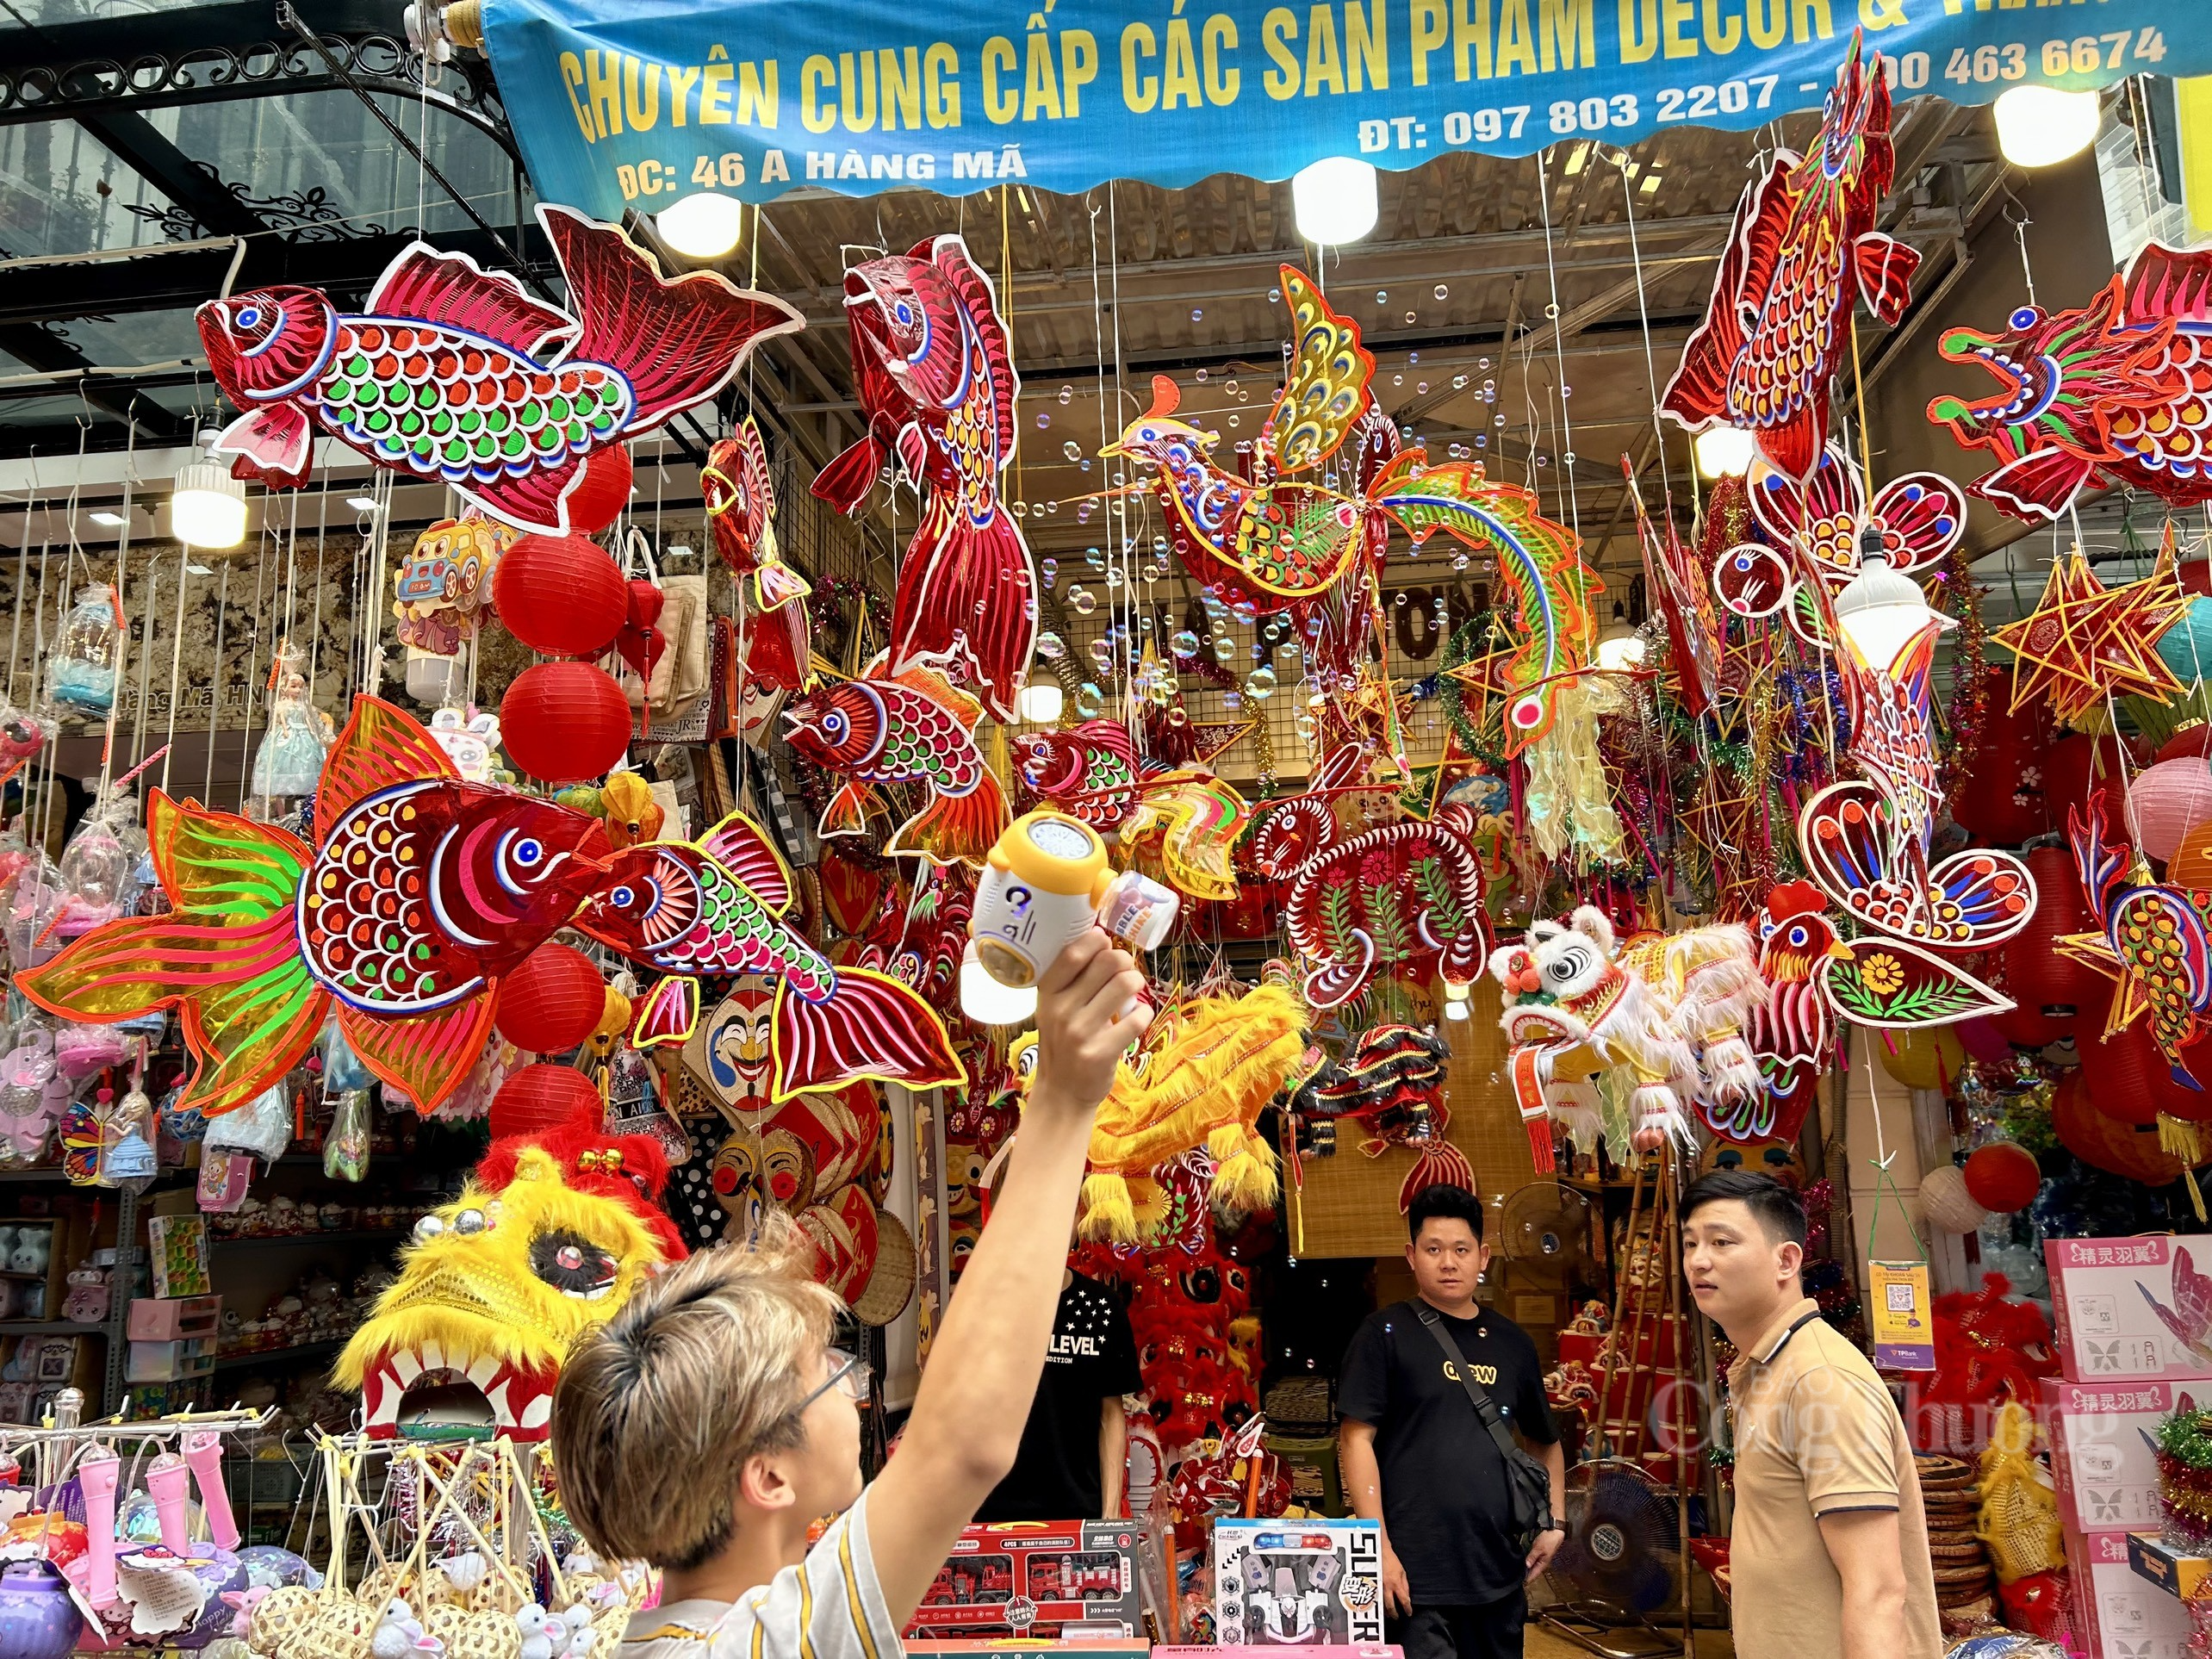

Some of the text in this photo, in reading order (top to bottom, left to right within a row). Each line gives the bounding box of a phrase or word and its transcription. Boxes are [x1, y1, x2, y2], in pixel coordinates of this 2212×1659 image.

[559, 45, 778, 144] CHUYÊN
[800, 42, 960, 134] CUNG
[981, 0, 1099, 125] CẤP
[1121, 0, 1240, 114] CÁC
[1358, 116, 1427, 153] ĐT:
[1443, 105, 1531, 143] 097
[1549, 94, 1638, 134] 803
[1656, 75, 1780, 122] 2207
[1944, 43, 2026, 84] 463
[2041, 26, 2167, 78] 6674
[618, 144, 1028, 201] ĐC: 46 A HÀNG MÃ
[227, 685, 265, 706] HN
[2079, 1246, 2153, 1265] 精灵羽翼
[1049, 1334, 1100, 1356] LEVEL
[1046, 1355, 1073, 1364] EDITION
[2082, 1391, 2155, 1412] 精灵羽翼
[1341, 1576, 1376, 1606] 变形
[1351, 1532, 1380, 1642] SUER
